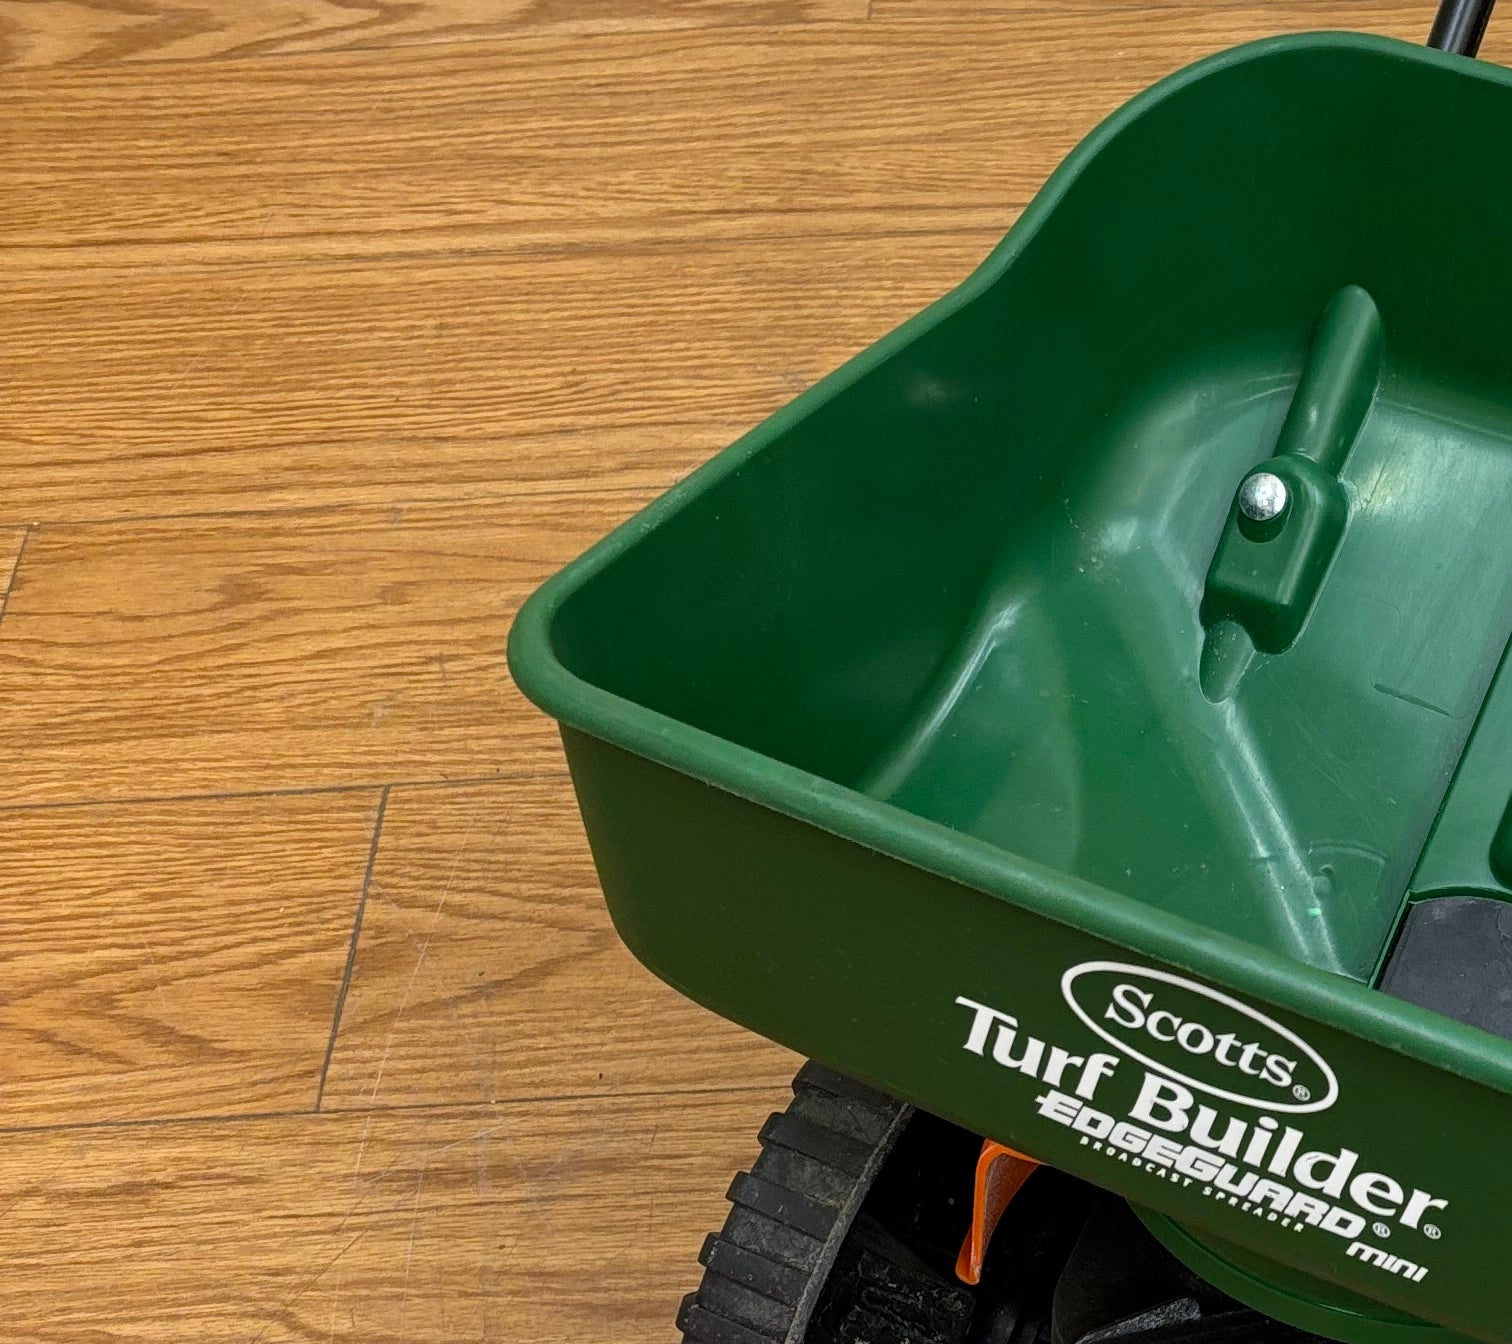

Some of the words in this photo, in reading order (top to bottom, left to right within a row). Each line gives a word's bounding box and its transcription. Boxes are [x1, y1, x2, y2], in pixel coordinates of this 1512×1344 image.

[956, 996, 1119, 1100] Turf
[1080, 1136, 1193, 1188] BROADCAST
[1202, 1186, 1304, 1233] SPREADER
